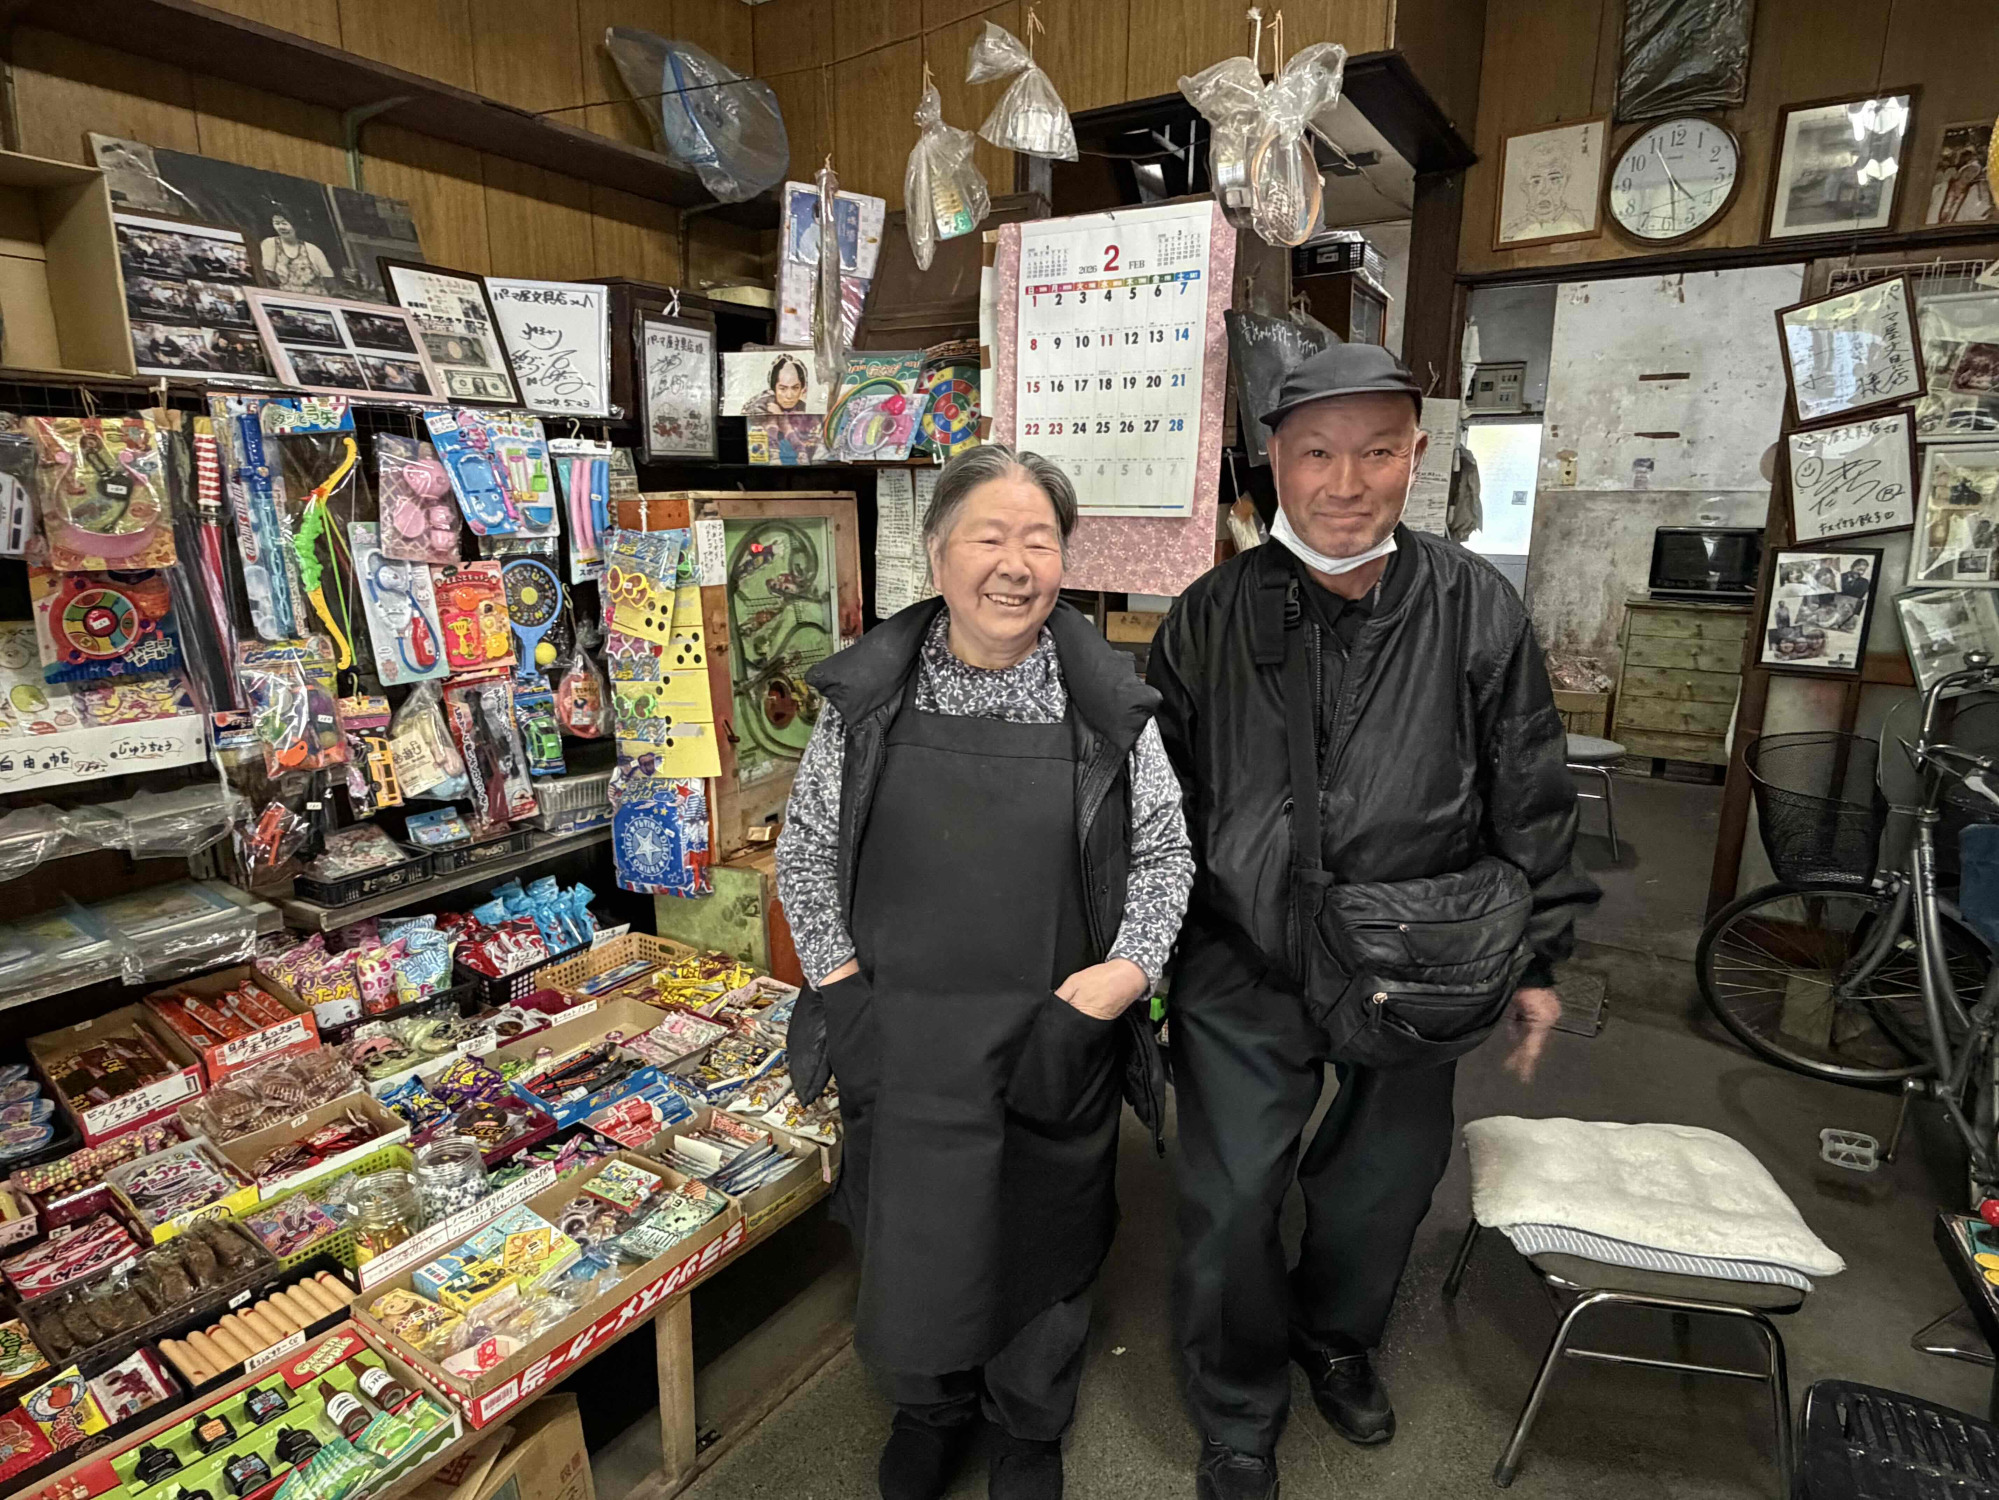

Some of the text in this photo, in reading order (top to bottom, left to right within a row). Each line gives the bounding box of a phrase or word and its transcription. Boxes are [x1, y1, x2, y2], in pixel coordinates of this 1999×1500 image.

[1651, 137, 1664, 154] 11
[1671, 130, 1686, 146] 12
[1698, 132, 1703, 148] 1
[1710, 146, 1720, 162] 2
[1631, 154, 1646, 172] 10
[1622, 178, 1632, 193] 9
[1626, 200, 1636, 214] 8
[1685, 208, 1694, 222] 5
[1641, 212, 1649, 228] 7
[1079, 244, 1145, 274] 2026 2 FEB
[1032, 282, 1188, 307] 1 2 3 4 5 6 7
[1031, 328, 1189, 350] 8 9 10 11 12 13 14
[1027, 374, 1185, 393] 15 16 17 18 19 20 21
[1025, 419, 1183, 435] 22 23 24 25 26 27 28
[1074, 463, 1177, 476] 3 4 5 6 7
[239, 514, 257, 556] SWORD
[118, 740, 173, 756] じゅうちょう
[128, 1160, 202, 1192] チョコケーキ
[367, 1372, 388, 1392] DRY
